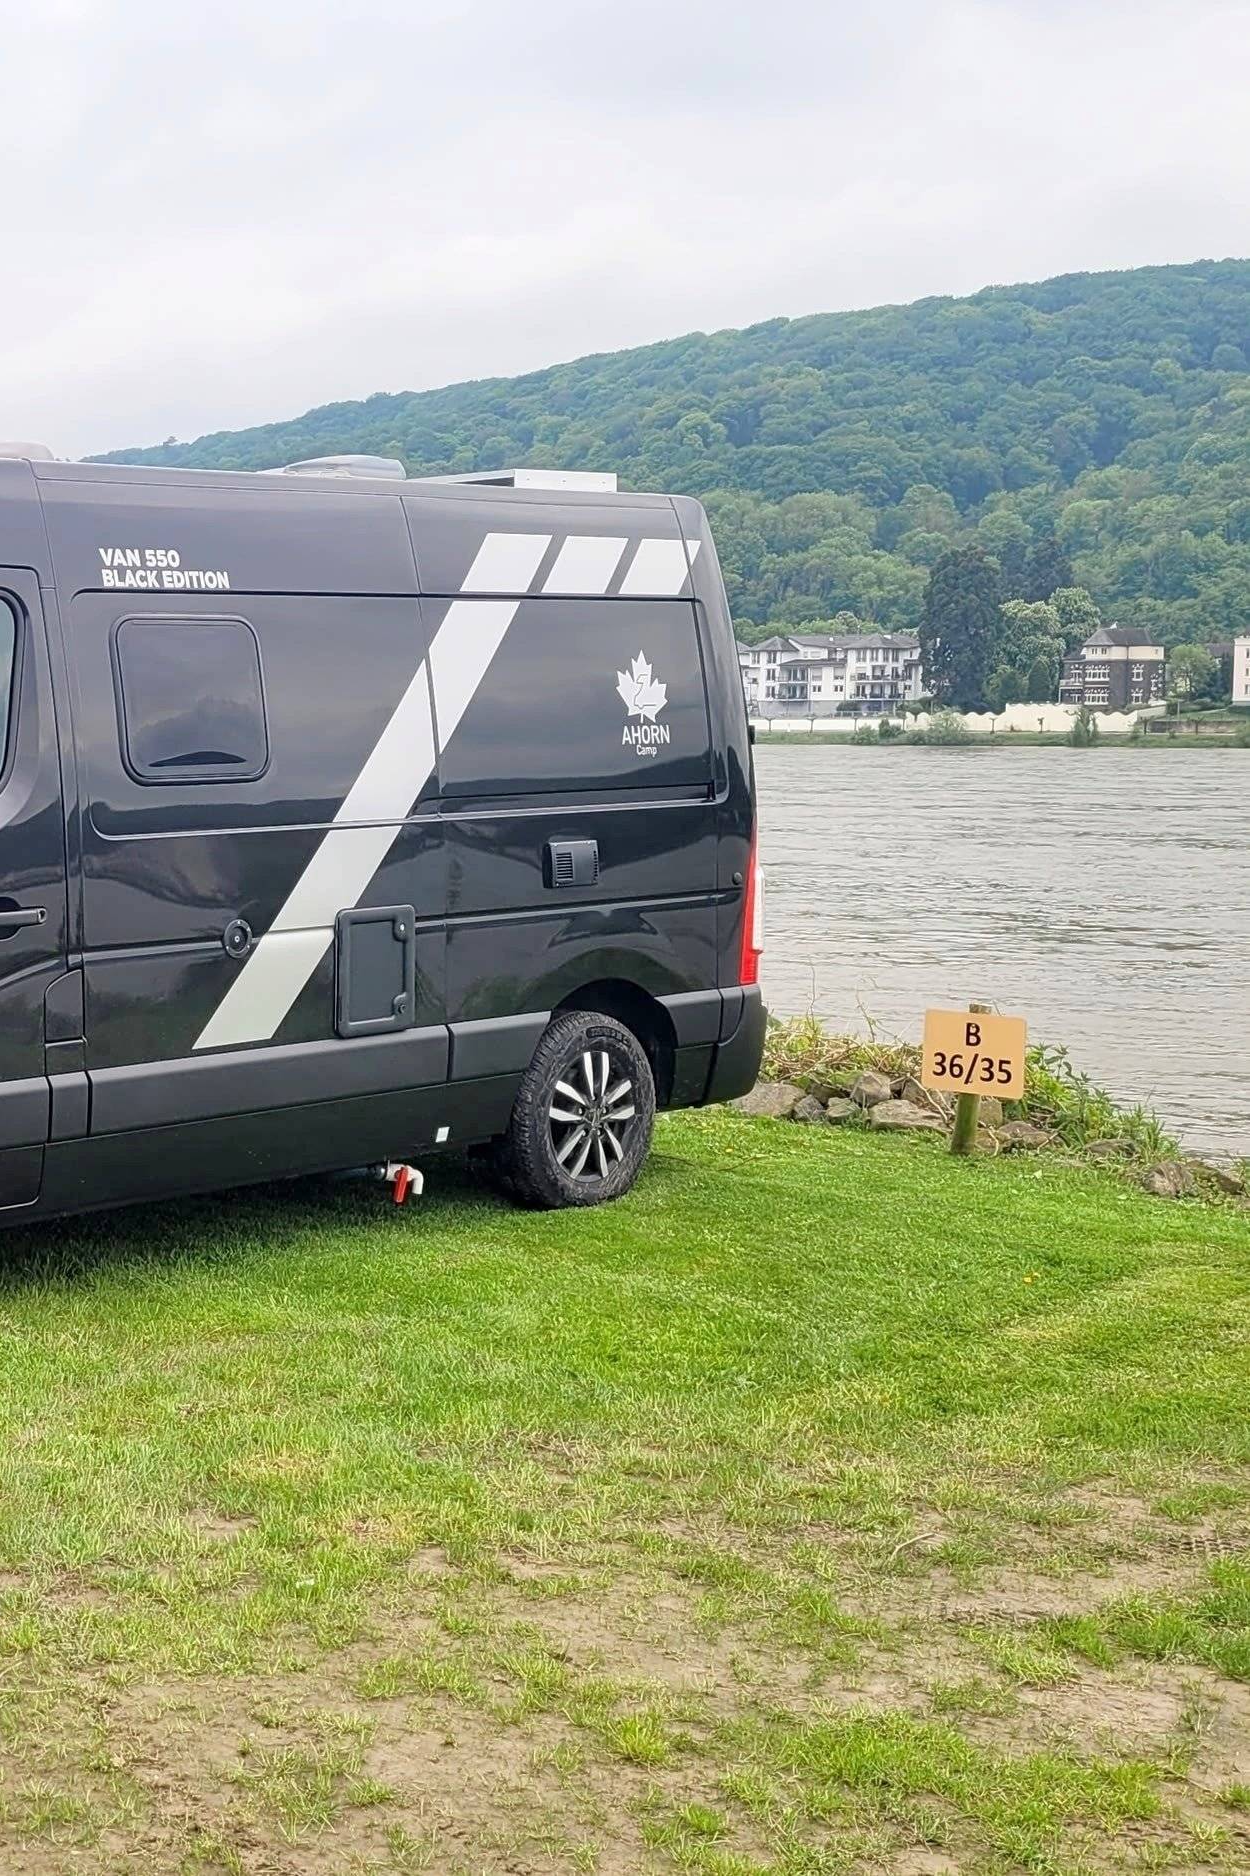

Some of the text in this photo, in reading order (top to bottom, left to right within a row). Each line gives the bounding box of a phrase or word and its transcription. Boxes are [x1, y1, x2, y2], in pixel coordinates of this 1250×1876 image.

[99, 548, 180, 567] VAN 550
[101, 569, 230, 589] BLACK EDITION
[622, 724, 670, 745] AHORN
[636, 744, 657, 758] Camp
[965, 1022, 981, 1047] B
[932, 1051, 1012, 1085] 36/35
